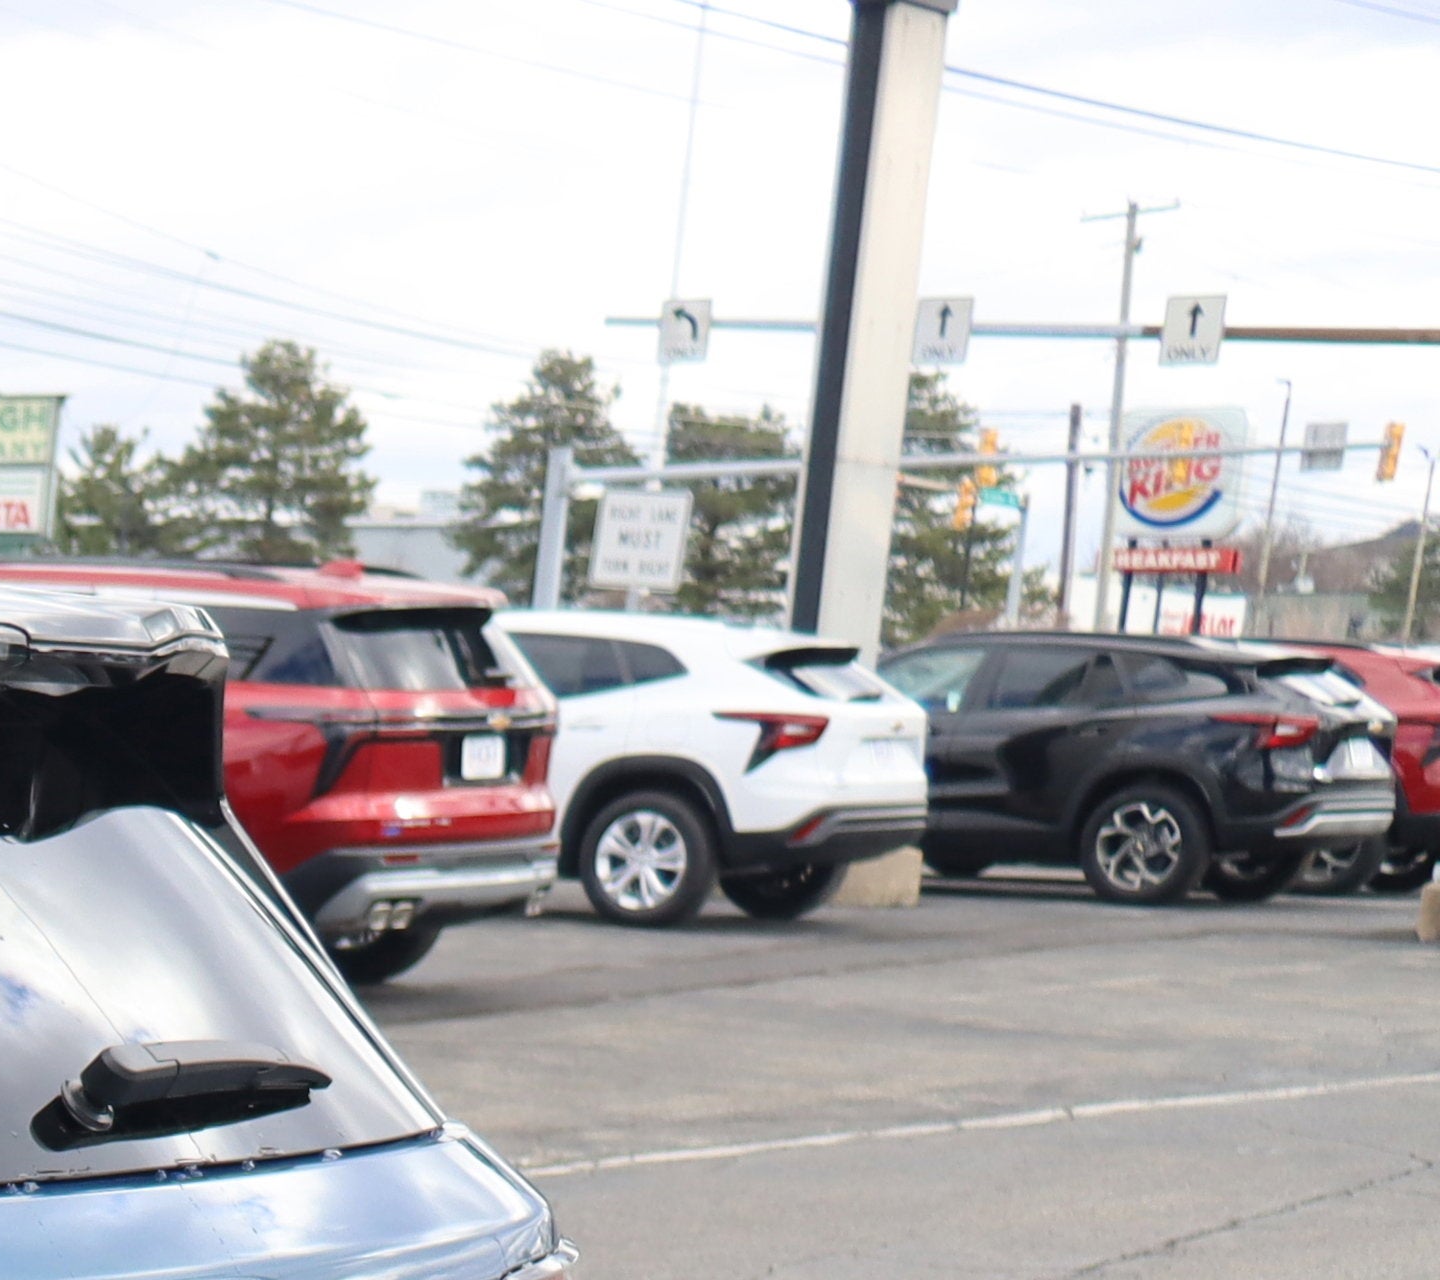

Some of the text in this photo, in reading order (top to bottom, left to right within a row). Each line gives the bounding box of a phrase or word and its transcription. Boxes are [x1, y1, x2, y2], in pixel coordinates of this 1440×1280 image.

[1166, 344, 1209, 360] ONLY
[618, 528, 662, 549] MUST
[1116, 551, 1221, 570] REAKFAST
